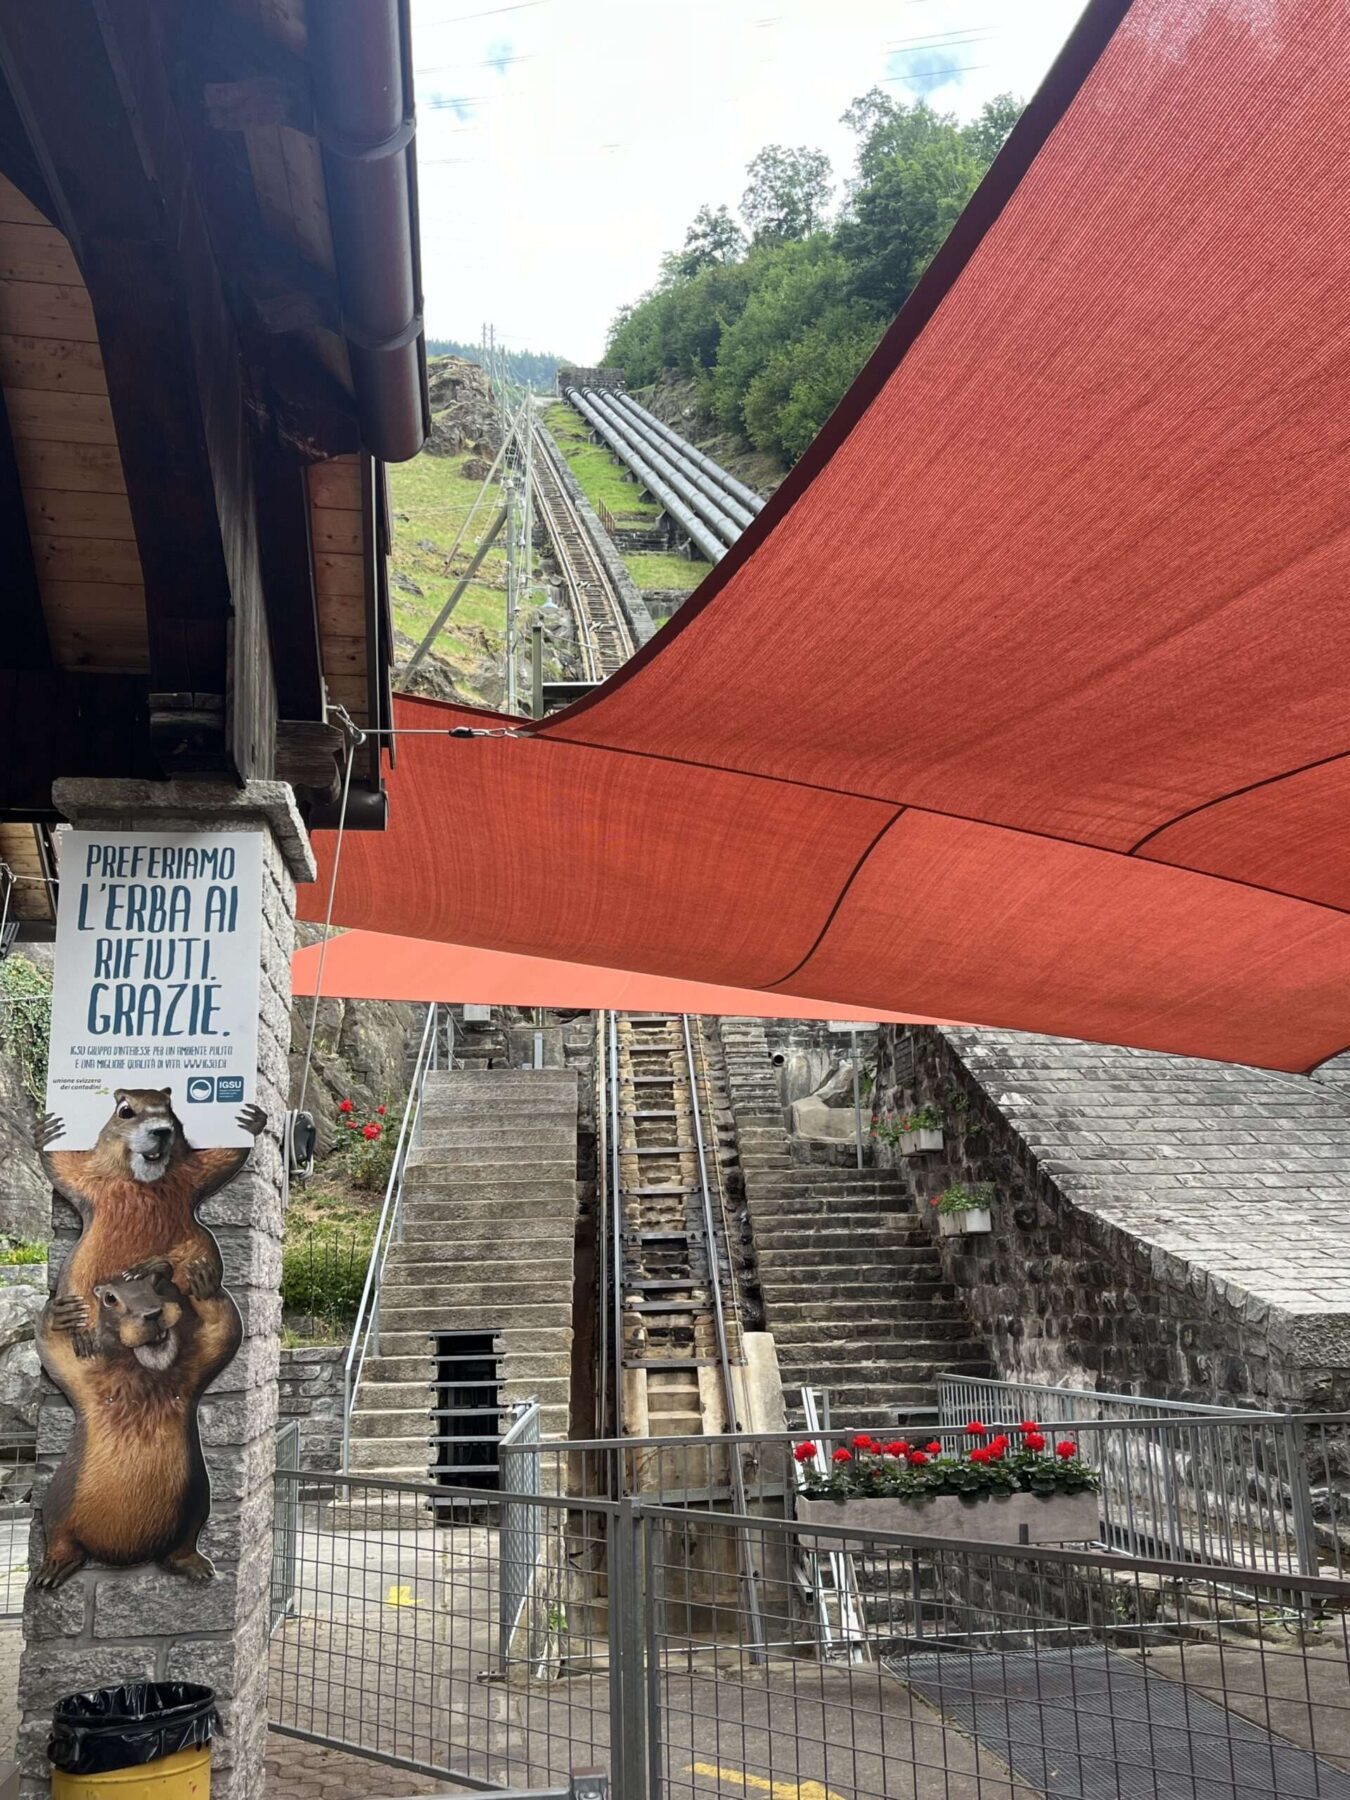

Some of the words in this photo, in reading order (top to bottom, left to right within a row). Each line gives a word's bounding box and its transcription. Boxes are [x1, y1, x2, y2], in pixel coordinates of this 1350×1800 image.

[86, 844, 236, 880] PREFERIAMO
[77, 883, 191, 933] L'ERBA
[204, 885, 239, 933] AI
[94, 938, 217, 980] RIFIUTI.
[87, 983, 231, 1037] GRAZIE.
[219, 1081, 242, 1089] IGSU
